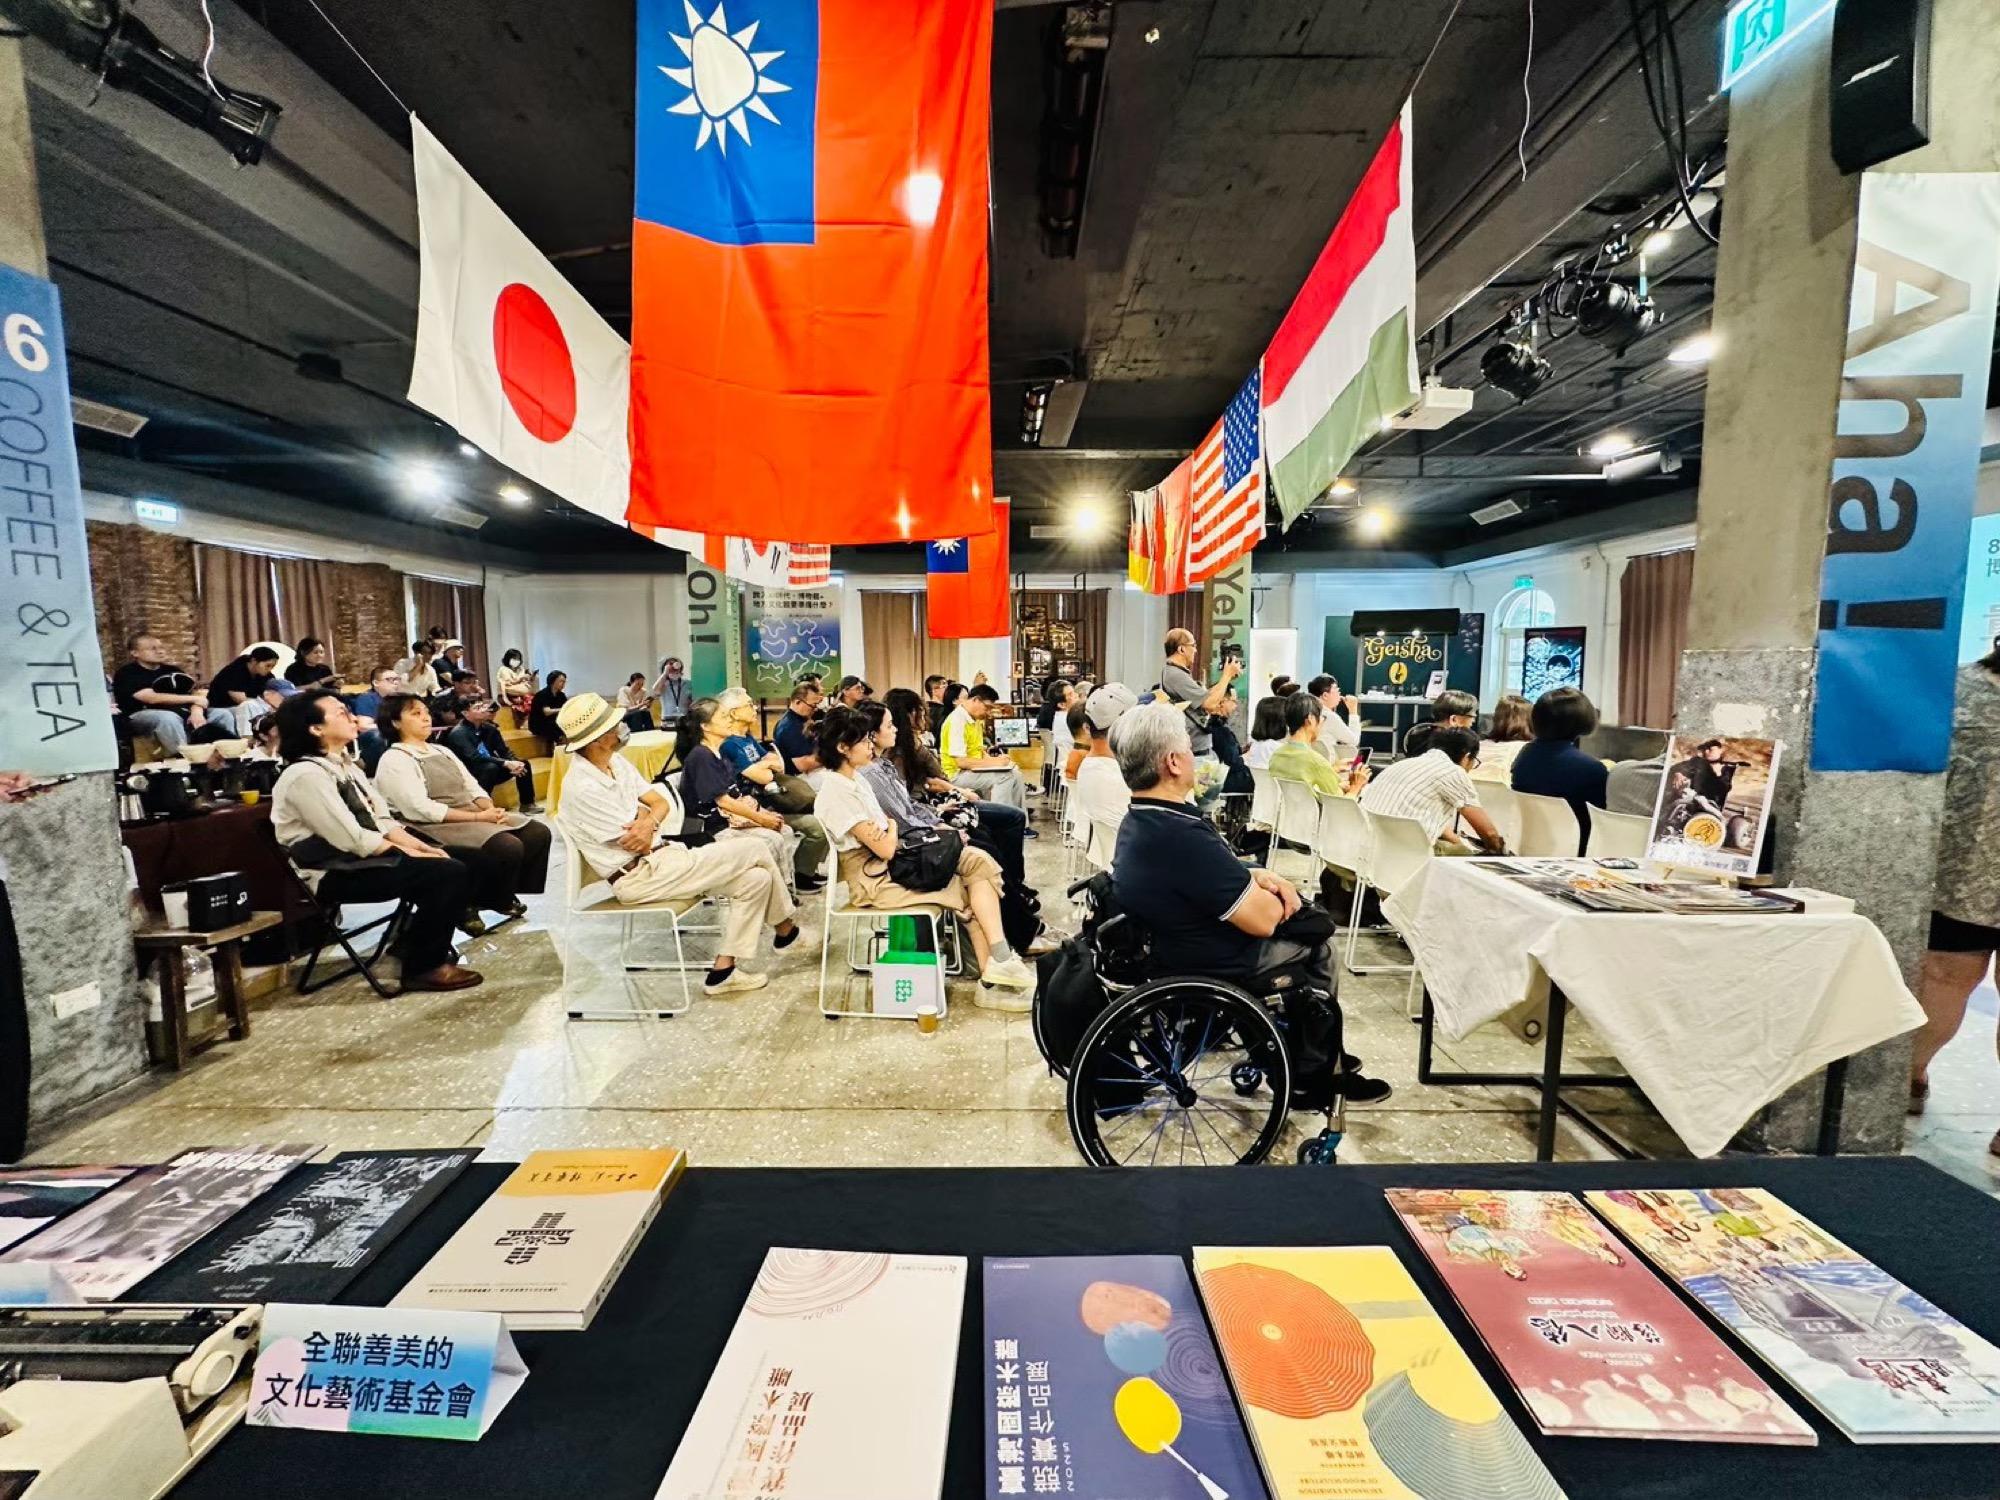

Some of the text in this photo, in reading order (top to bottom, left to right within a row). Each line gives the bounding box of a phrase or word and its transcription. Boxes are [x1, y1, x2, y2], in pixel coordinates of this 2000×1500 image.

[4, 313, 50, 372] 6
[1819, 240, 1971, 630] Aha!
[0, 377, 87, 742] COFFEE & TEA
[688, 570, 720, 643] Oh!
[1213, 567, 1244, 658] Yeh
[1363, 635, 1442, 665] Geisha
[302, 1330, 454, 1371] 全聯善美的
[262, 1373, 476, 1420] 文化藝術基金會
[994, 1339, 1027, 1494] 臺灣國際木雕
[1025, 1360, 1061, 1494] 競賽作品展
[1062, 1441, 1075, 1492] 2025
